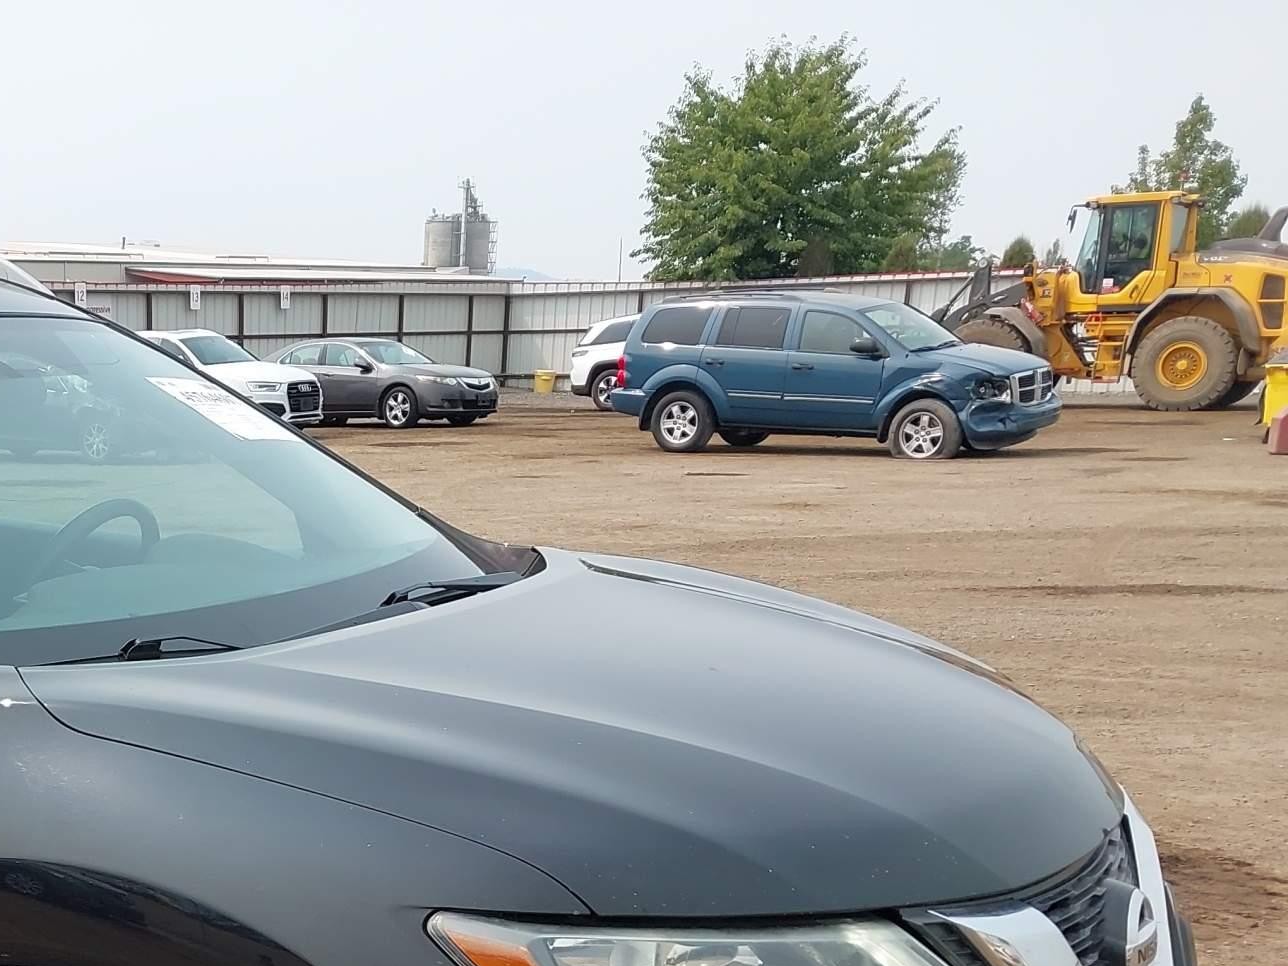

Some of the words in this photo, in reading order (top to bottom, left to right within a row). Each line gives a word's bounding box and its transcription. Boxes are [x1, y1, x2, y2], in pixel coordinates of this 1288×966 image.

[76, 289, 85, 302] 12
[192, 291, 199, 303] 13
[282, 291, 289, 302] 14
